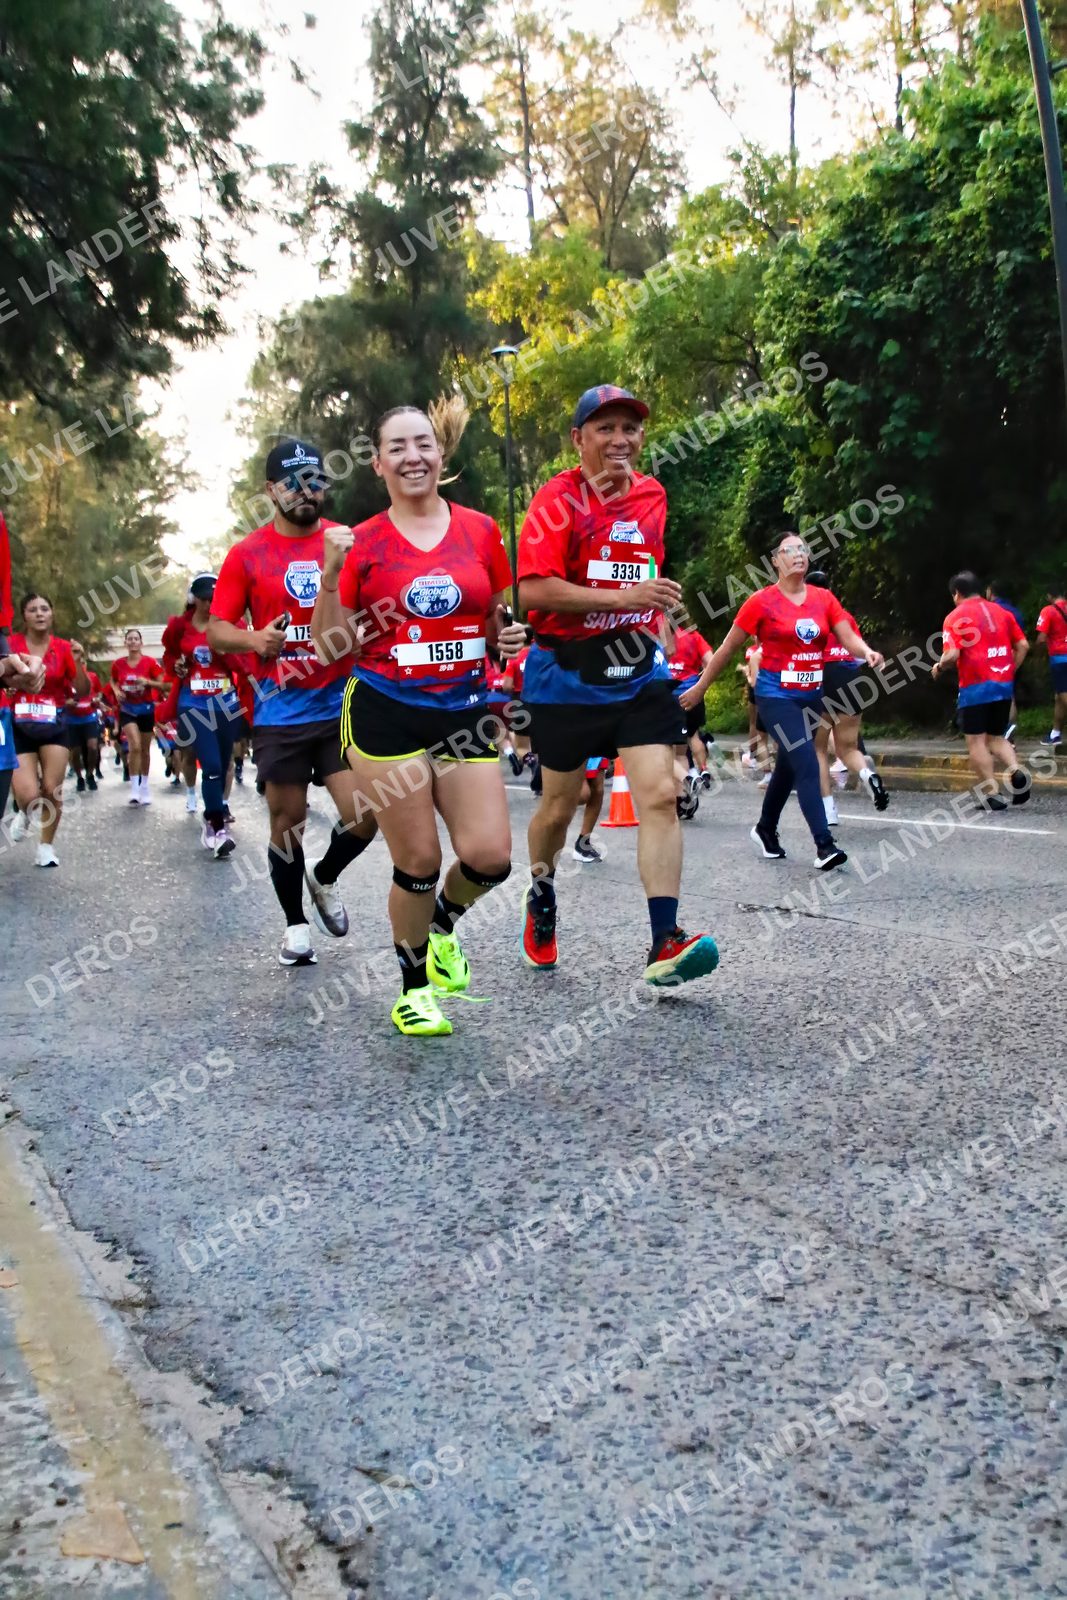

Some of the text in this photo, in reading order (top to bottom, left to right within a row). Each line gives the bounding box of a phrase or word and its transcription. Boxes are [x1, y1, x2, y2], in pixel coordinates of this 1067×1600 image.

[612, 563, 641, 580] 3334
[418, 587, 448, 596] Global
[414, 594, 437, 603] Race
[428, 641, 464, 662] 1558
[797, 672, 815, 682] 1220
[202, 680, 220, 689] 2452
